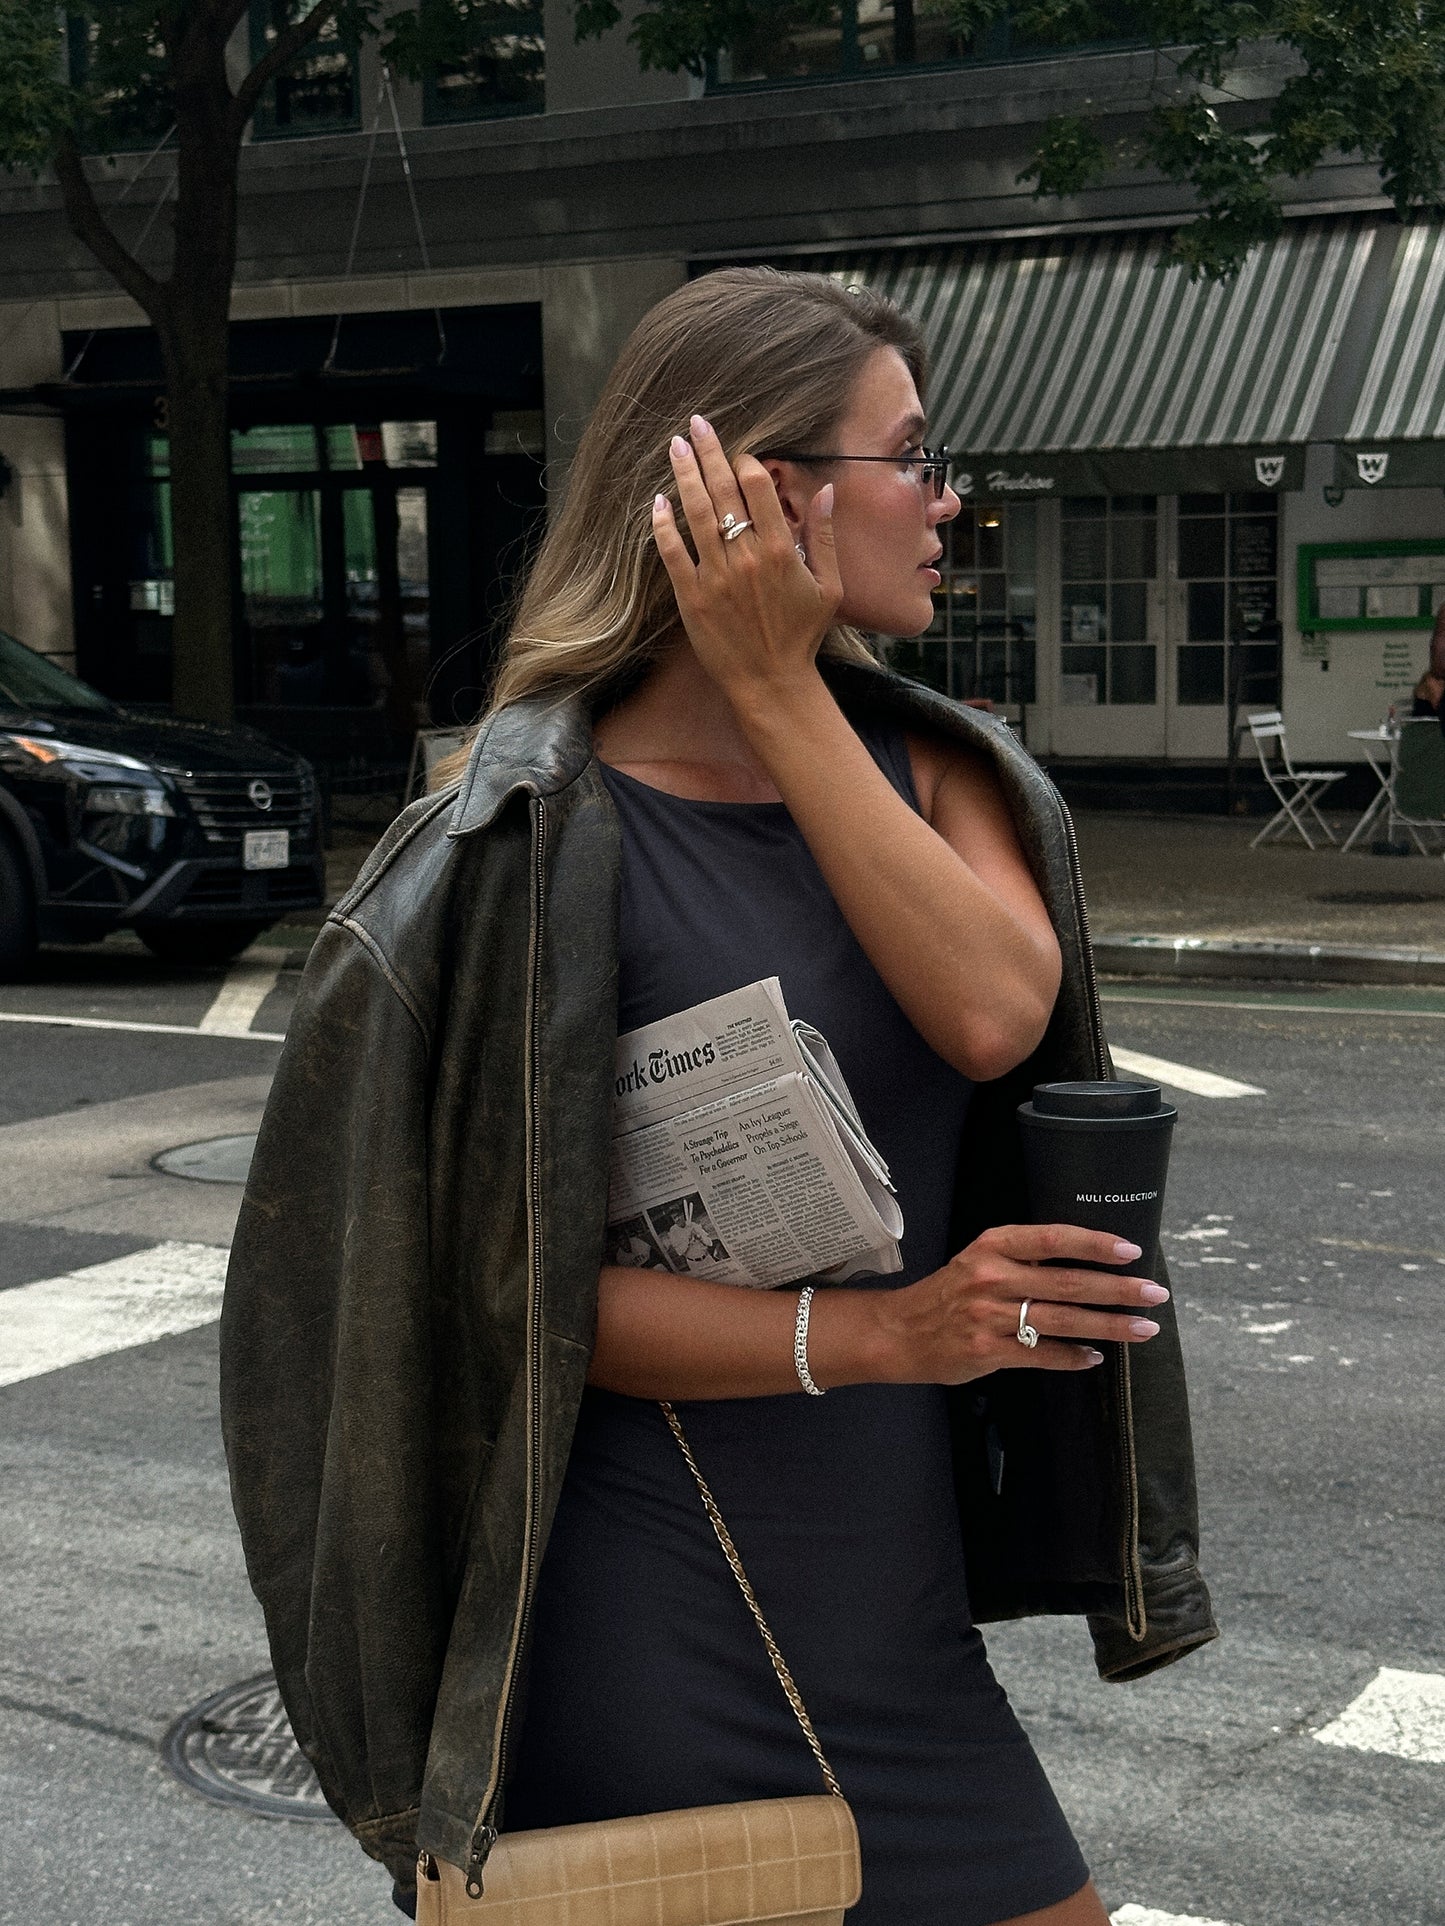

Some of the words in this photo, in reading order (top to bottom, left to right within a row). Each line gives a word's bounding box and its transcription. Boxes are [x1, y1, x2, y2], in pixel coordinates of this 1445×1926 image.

[615, 1060, 649, 1097] ork
[649, 1042, 716, 1083] Times
[738, 1122, 751, 1132] An
[750, 1117, 762, 1128] Ivy
[762, 1108, 791, 1124] Leaguer
[746, 1128, 774, 1144] Propels
[779, 1119, 800, 1133] Siege
[683, 1142, 690, 1152] A
[689, 1135, 715, 1151] Strange
[713, 1129, 729, 1141] Trip
[753, 1144, 767, 1156] On
[766, 1140, 781, 1151] Top
[780, 1130, 809, 1147] Schools
[690, 1153, 700, 1164] To
[699, 1141, 740, 1162] Psychedelics
[698, 1164, 712, 1176] For
[716, 1153, 748, 1169] Governor
[1076, 1193, 1102, 1203] MULI
[1104, 1190, 1158, 1203] COLLECTION
